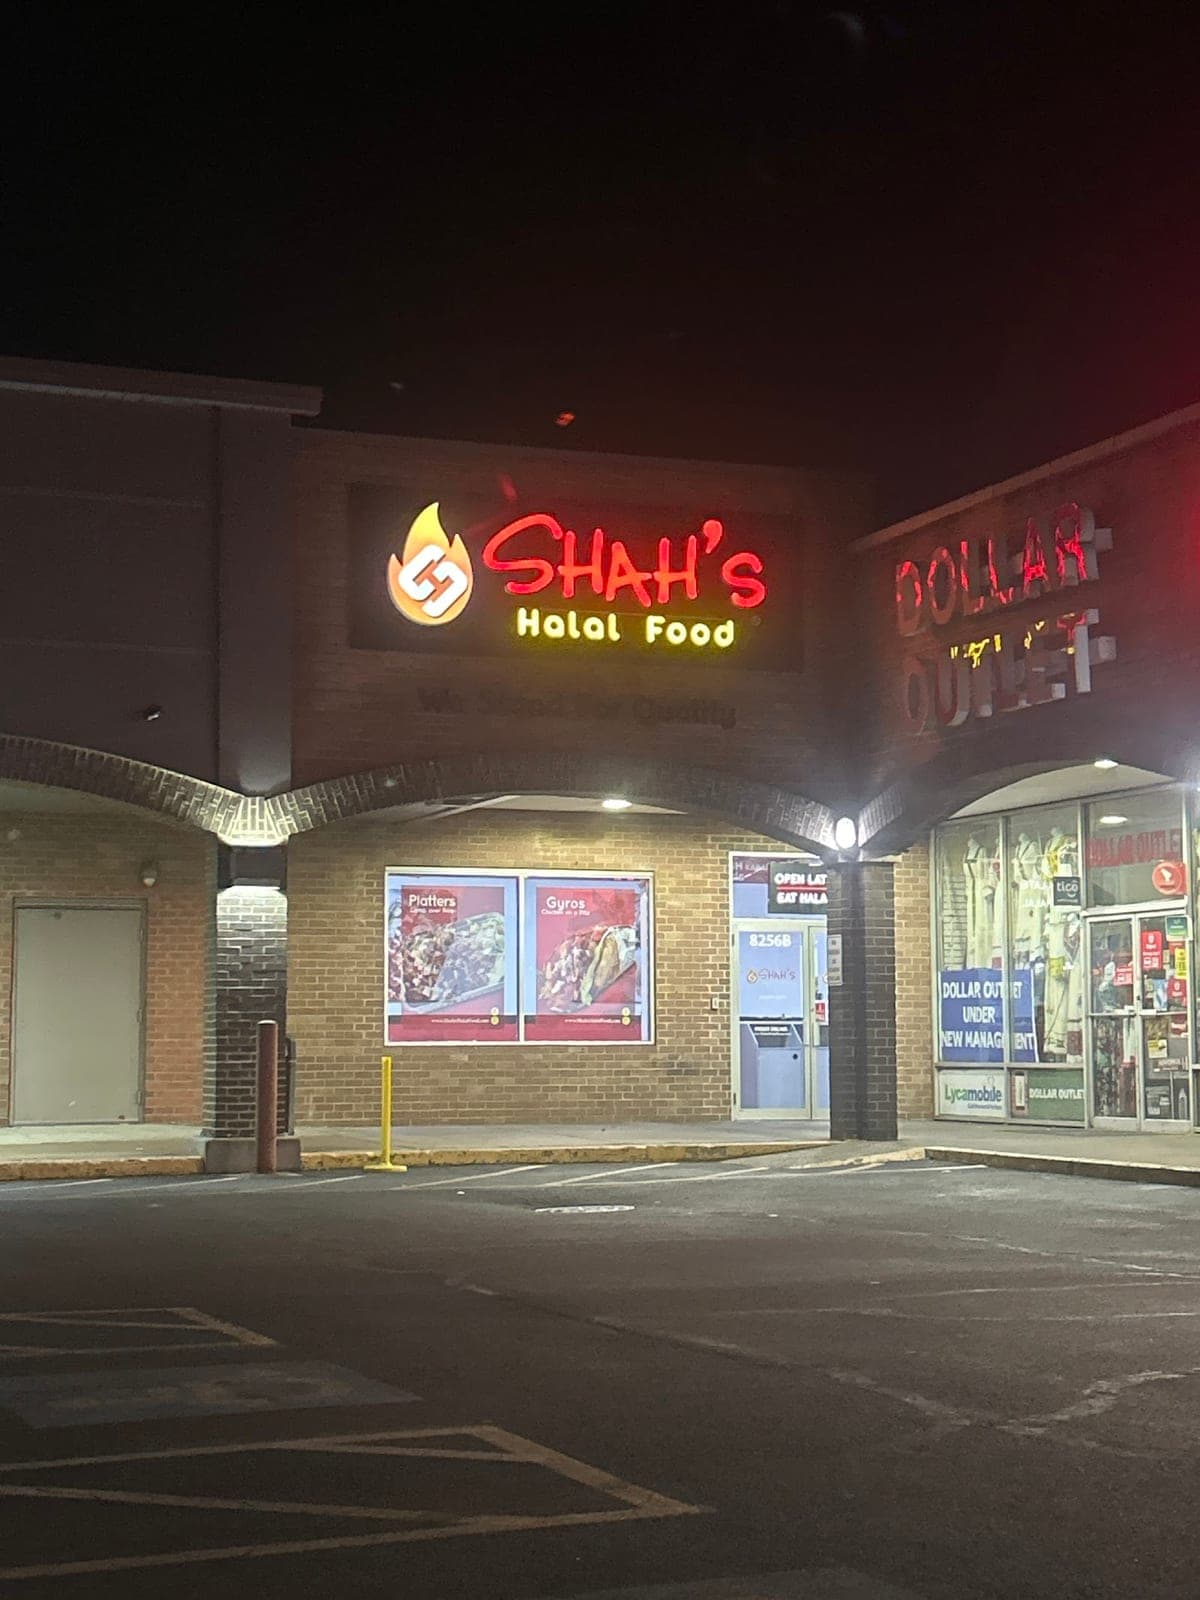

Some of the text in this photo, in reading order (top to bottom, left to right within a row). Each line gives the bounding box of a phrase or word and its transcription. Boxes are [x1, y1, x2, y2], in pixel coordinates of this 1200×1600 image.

[482, 513, 766, 608] SHAH'S
[895, 502, 1100, 636] DOLLAR
[516, 607, 735, 647] Halal Food
[774, 873, 828, 886] OPEN LAT
[408, 894, 456, 907] Platters
[546, 896, 586, 912] Gyros
[777, 892, 829, 904] EAT HALA
[749, 934, 792, 947] 8256B
[942, 981, 1023, 999] DOLLAR OUTET
[962, 1006, 996, 1023] UNDER
[941, 1030, 1035, 1050] NEW MANAGENT
[944, 1084, 1002, 1104] Lycamobile
[1029, 1087, 1058, 1099] DOLLAR
